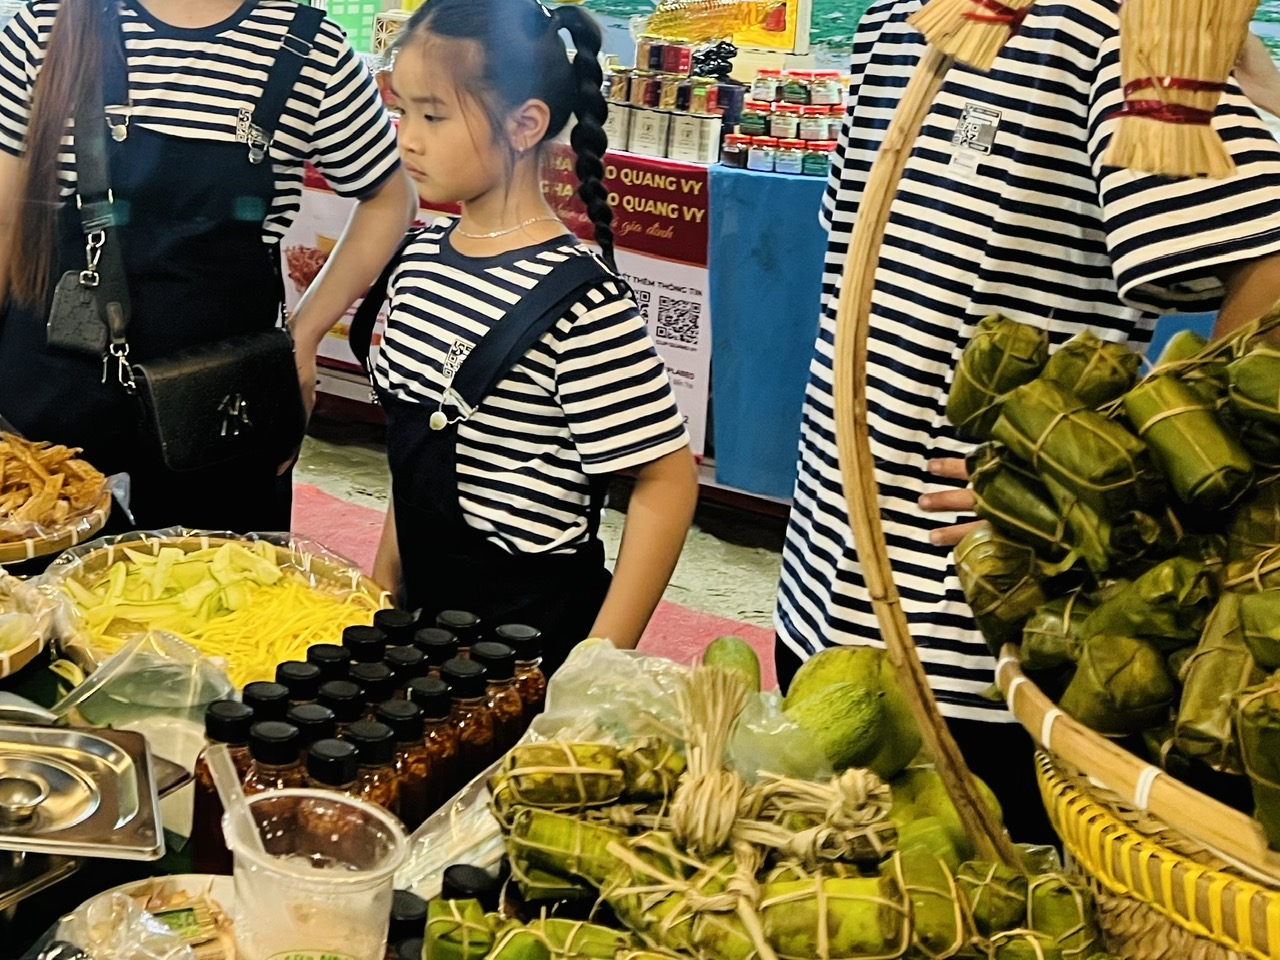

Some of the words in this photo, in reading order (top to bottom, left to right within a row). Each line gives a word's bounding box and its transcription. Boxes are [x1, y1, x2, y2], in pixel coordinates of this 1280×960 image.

[620, 167, 677, 191] QUANG
[681, 178, 704, 195] VY
[623, 194, 679, 219] QUANG
[682, 205, 706, 223] VY
